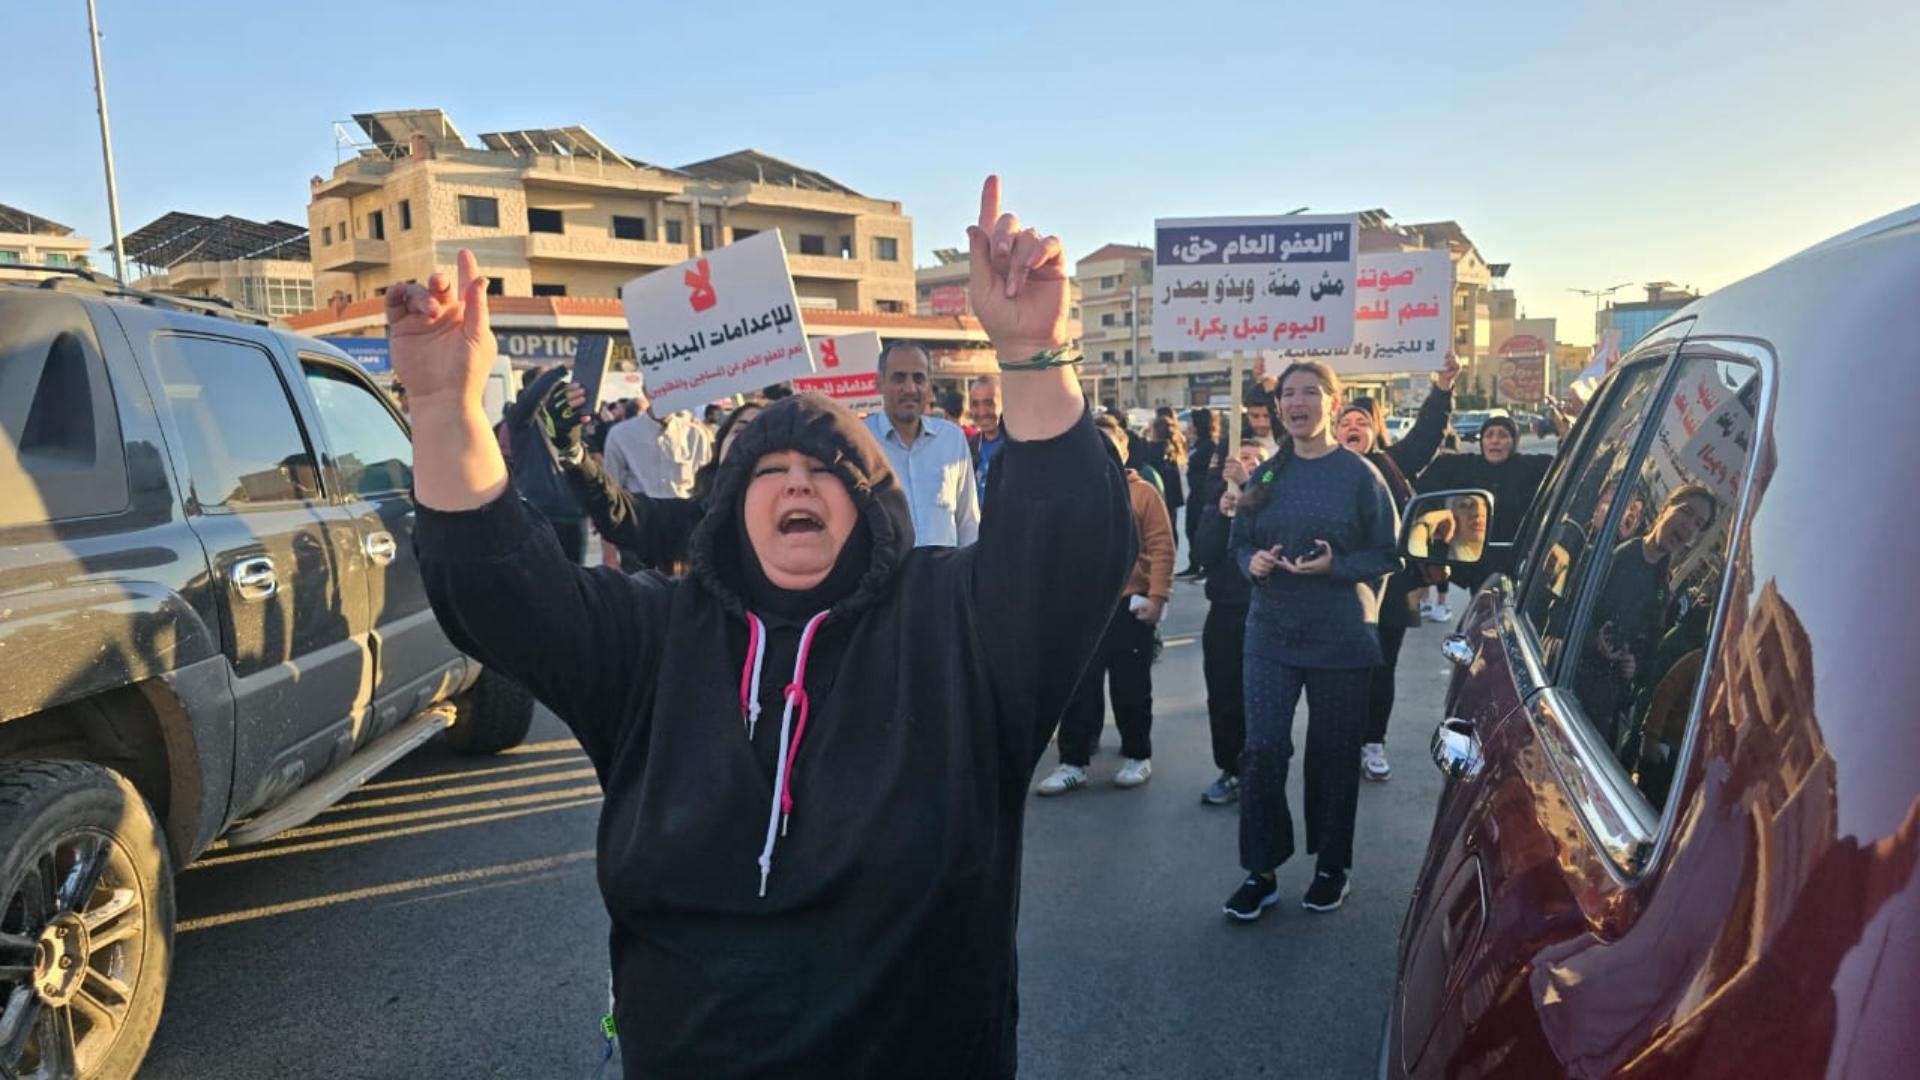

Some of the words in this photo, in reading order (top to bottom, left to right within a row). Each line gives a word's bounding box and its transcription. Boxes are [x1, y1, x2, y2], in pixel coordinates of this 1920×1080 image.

[1172, 236, 1217, 263] حق،
[1222, 234, 1275, 264] العام
[1280, 231, 1344, 261] "العفو
[684, 258, 717, 313] لا
[1161, 278, 1209, 304] يصدر
[1310, 270, 1344, 301] مش
[1357, 268, 1423, 291] "صوتن
[1355, 299, 1389, 320] للع
[1398, 296, 1440, 325] نعم
[710, 304, 793, 346] للإعدامات
[1233, 316, 1268, 341] قبل
[1273, 316, 1325, 341] اليوم
[640, 332, 706, 371] الميدانية
[820, 338, 839, 368] لا
[1373, 340, 1421, 358] للتمييز
[1426, 339, 1437, 353] لا
